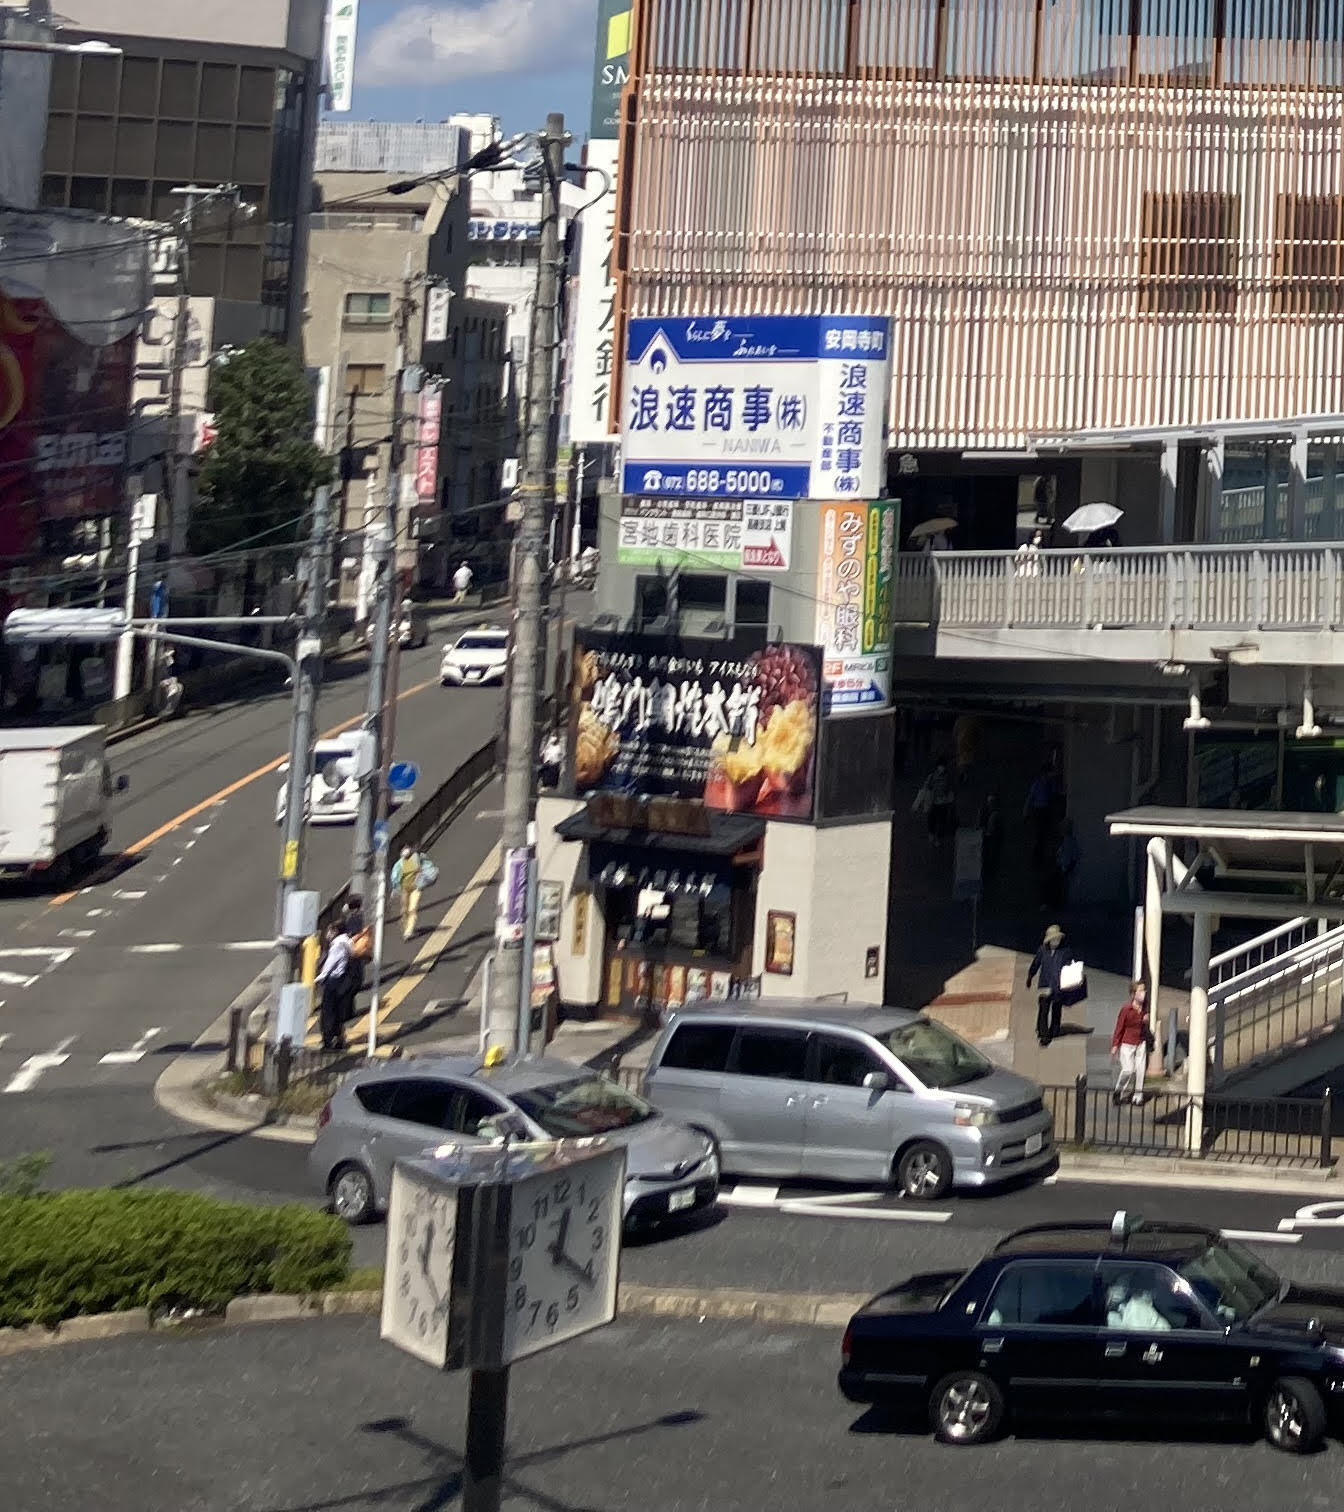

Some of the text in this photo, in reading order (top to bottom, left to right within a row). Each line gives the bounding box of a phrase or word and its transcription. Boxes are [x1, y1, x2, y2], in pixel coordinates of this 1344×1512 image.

[824, 328, 884, 352] 安岡寺町
[721, 438, 781, 455] NANIWA
[622, 520, 742, 551] 宮地歯科医院
[835, 511, 864, 652] みずのや眼科
